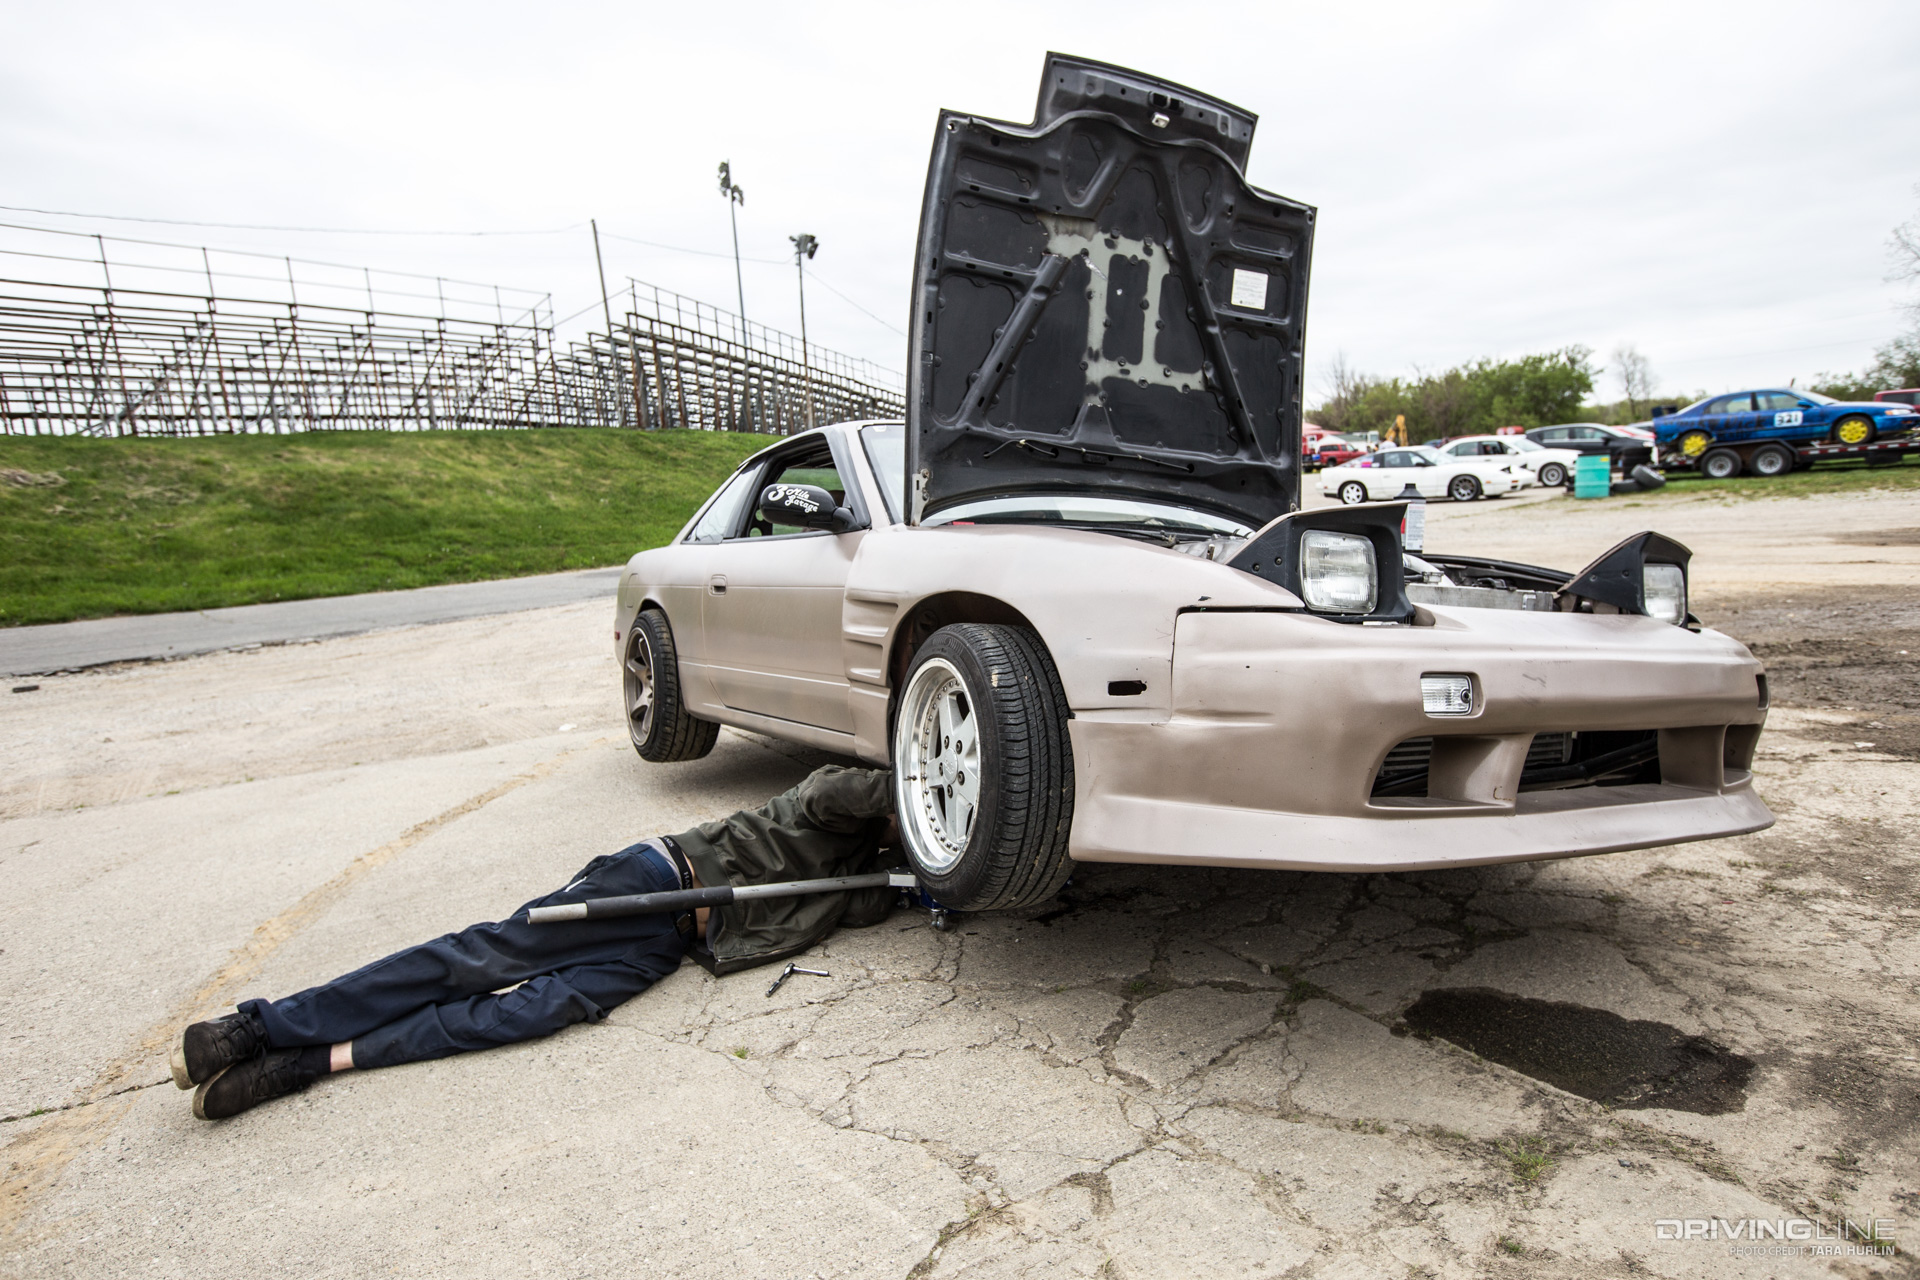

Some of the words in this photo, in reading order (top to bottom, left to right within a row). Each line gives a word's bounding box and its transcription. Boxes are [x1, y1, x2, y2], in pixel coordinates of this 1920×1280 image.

[1777, 414, 1798, 426] 321
[768, 485, 788, 501] 3
[786, 488, 810, 499] Mile
[784, 494, 819, 513] Garage
